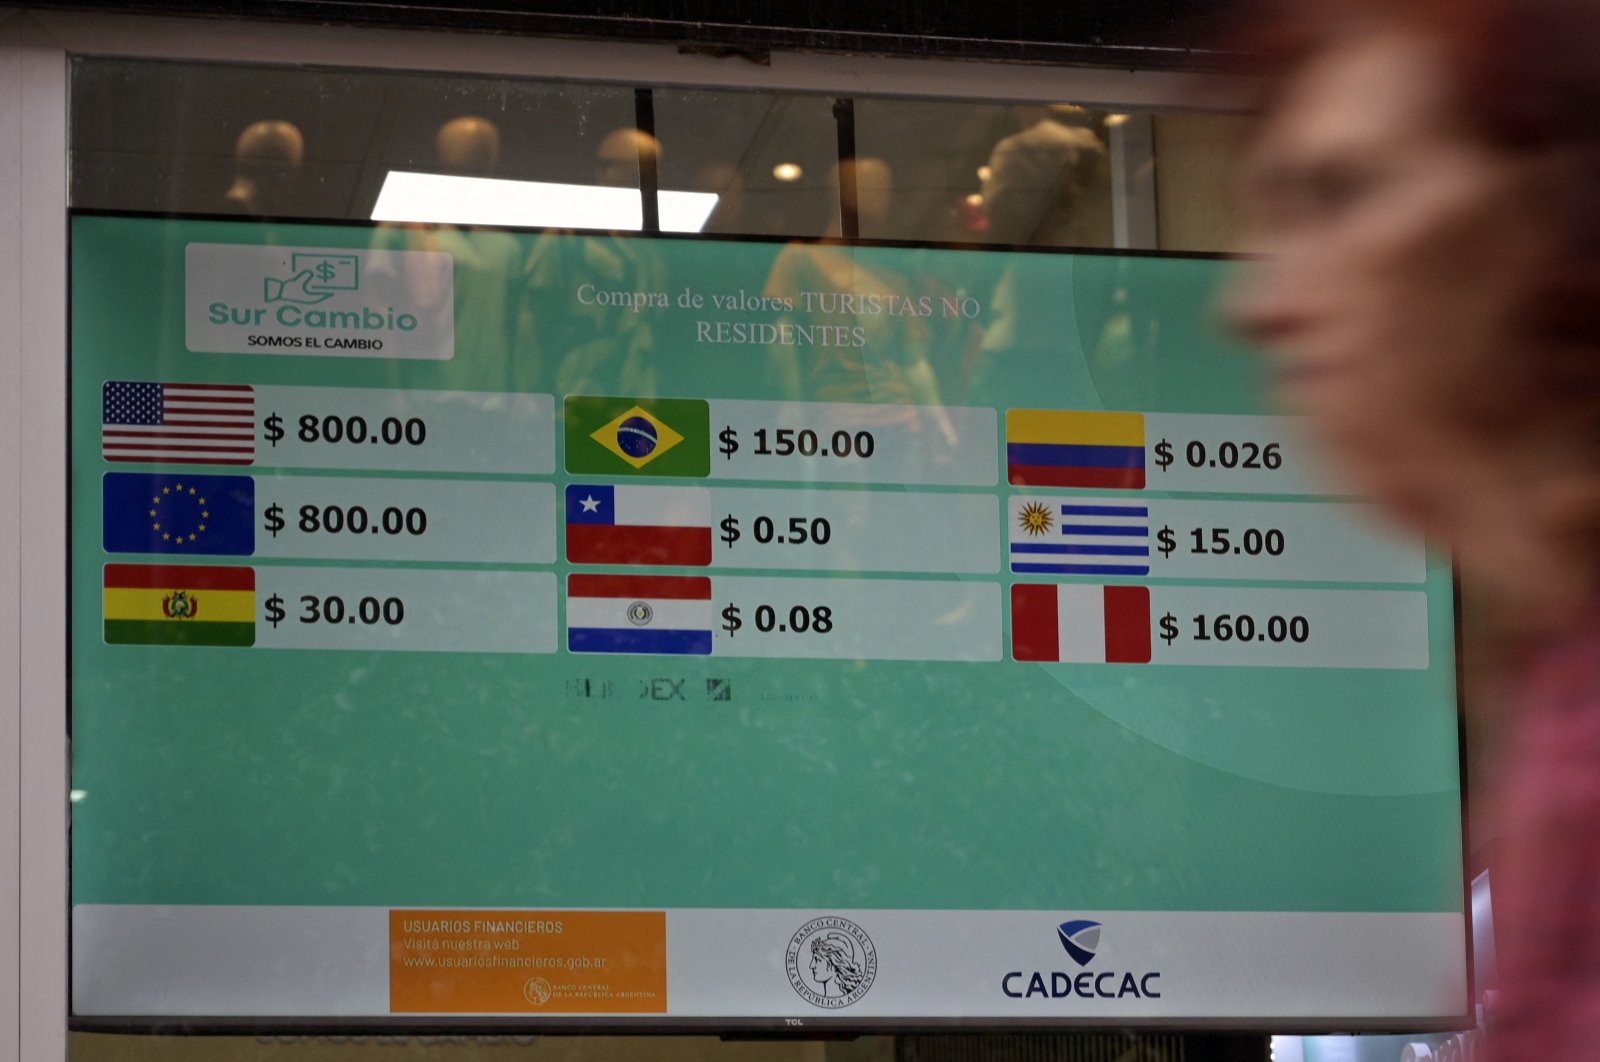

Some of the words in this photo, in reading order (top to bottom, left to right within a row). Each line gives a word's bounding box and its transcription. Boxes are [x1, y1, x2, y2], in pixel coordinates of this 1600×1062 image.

[208, 302, 267, 327] Sur
[276, 304, 418, 332] Cambio
[576, 283, 669, 313] Compra
[677, 288, 704, 309] de
[712, 289, 794, 312] valores
[800, 291, 934, 317] TURISTAS
[942, 296, 981, 319] NO
[248, 335, 302, 347] SOMOS
[305, 337, 321, 348] EL
[324, 338, 383, 350] CAMBIO
[696, 321, 866, 347] RESIDENTES
[264, 412, 284, 447] $
[298, 414, 426, 446] 800.00
[719, 426, 738, 460] $
[753, 428, 875, 458] 150.00
[1154, 438, 1174, 472] $
[1186, 440, 1282, 470] 0.026
[264, 503, 285, 537] $
[299, 505, 427, 535] 800.00
[720, 514, 740, 548] $
[753, 516, 831, 545] 0.50
[1157, 525, 1177, 559] $
[1190, 528, 1285, 556] 15.00
[265, 593, 286, 628] $
[299, 595, 404, 625] 30.00
[721, 603, 742, 637] $
[755, 605, 833, 633] 0.08
[1159, 612, 1179, 646] $
[1193, 614, 1309, 643] 160.00
[403, 920, 471, 933] USUARIOS
[474, 920, 563, 934] FINANCIEROS
[403, 937, 439, 950] Visitá
[442, 939, 491, 951] nuestra
[494, 938, 520, 951] web
[794, 919, 825, 945] BANCO
[826, 919, 868, 946] CENTRAL
[403, 954, 607, 971] www.usuariosfinancieros.gob.ar
[847, 951, 875, 1003] ARGENTINA
[1002, 971, 1161, 998] CADECAC
[784, 1018, 803, 1026] TCL
